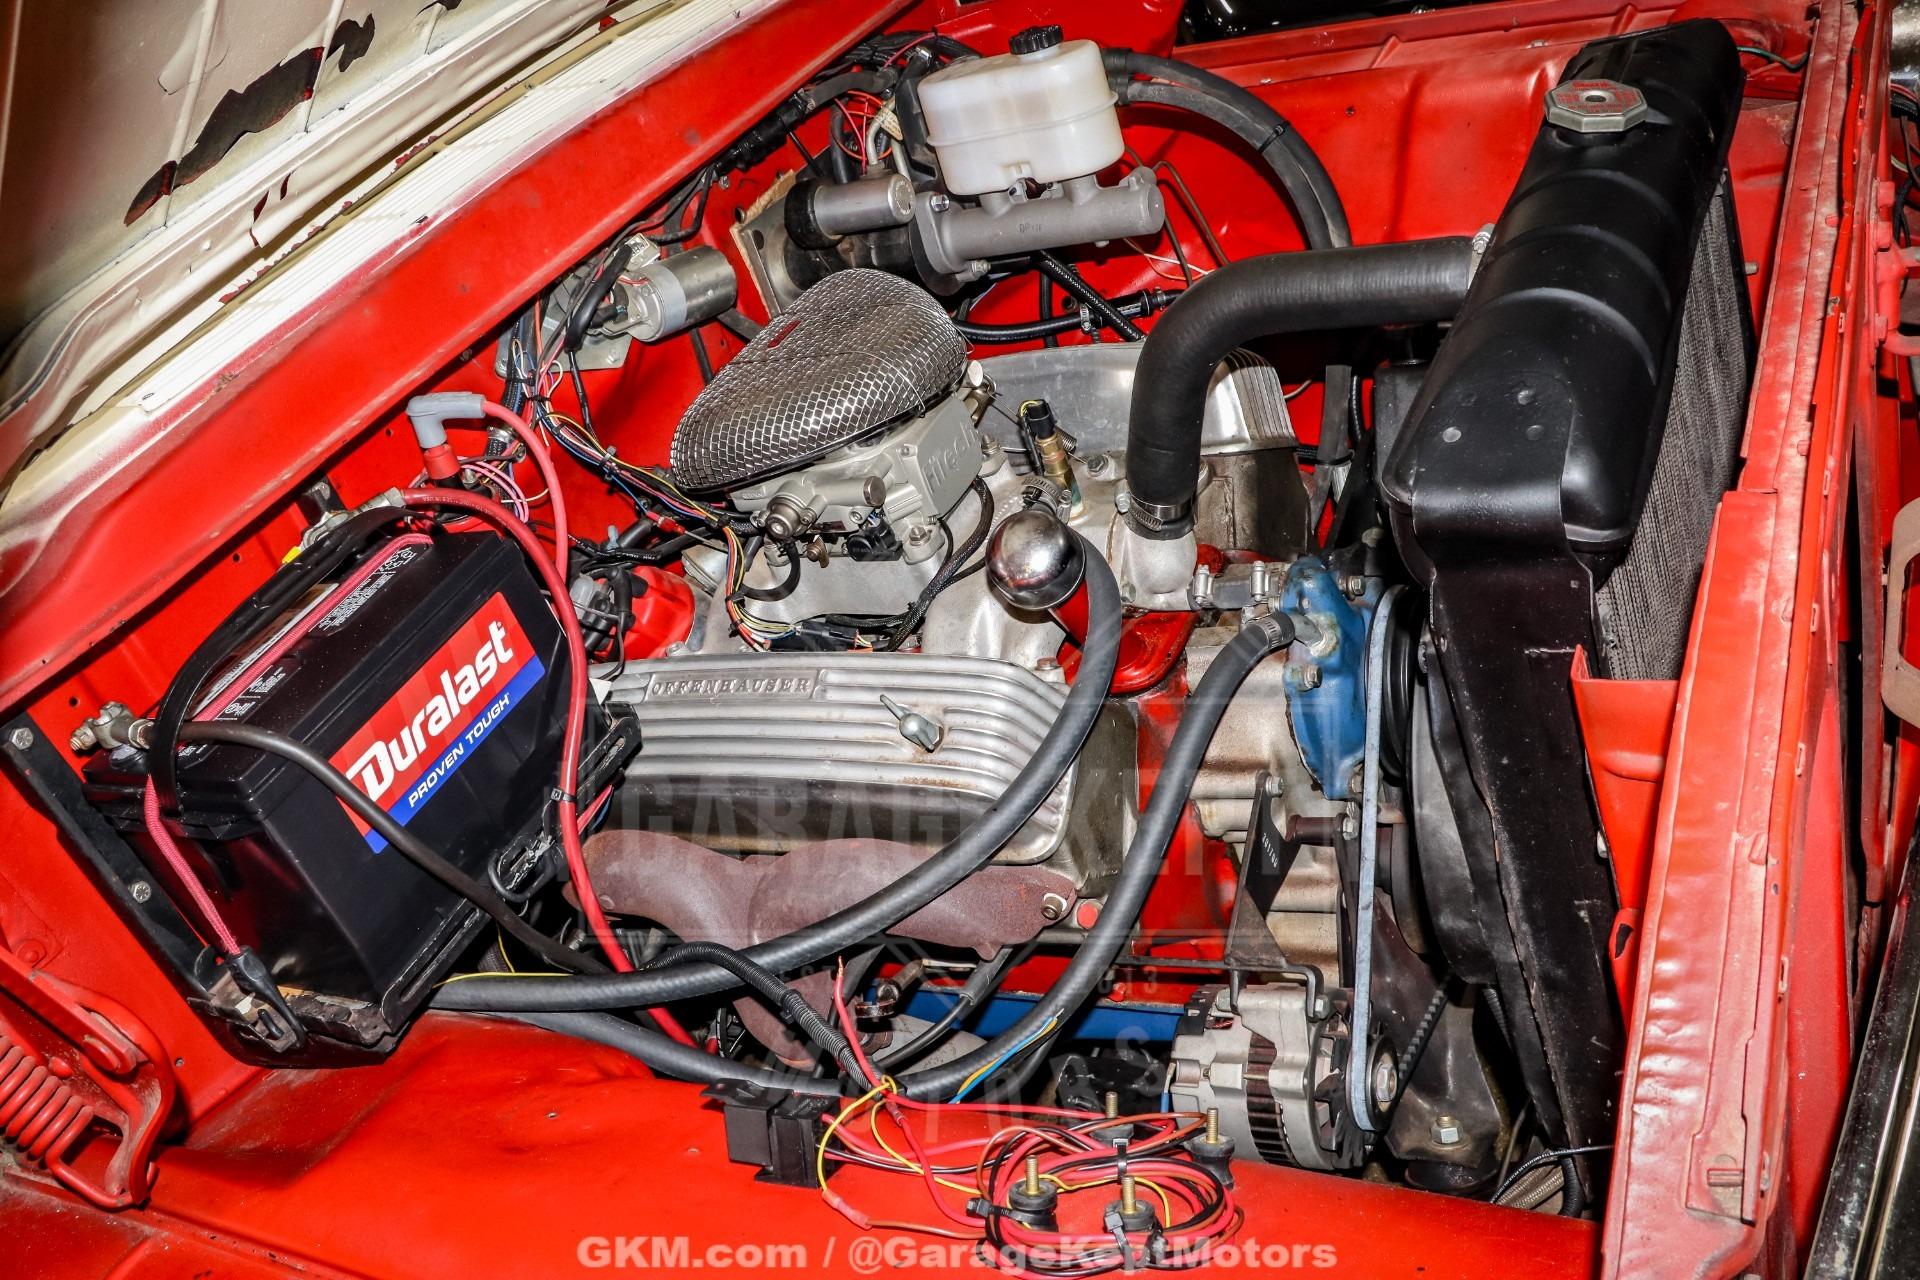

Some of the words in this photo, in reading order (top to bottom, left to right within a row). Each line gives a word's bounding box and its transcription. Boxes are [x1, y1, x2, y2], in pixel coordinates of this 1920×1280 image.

[345, 620, 514, 802] Duralast
[651, 677, 812, 696] OFFENHAUSER
[408, 742, 465, 808] PROVEN
[465, 693, 511, 745] TOUGH
